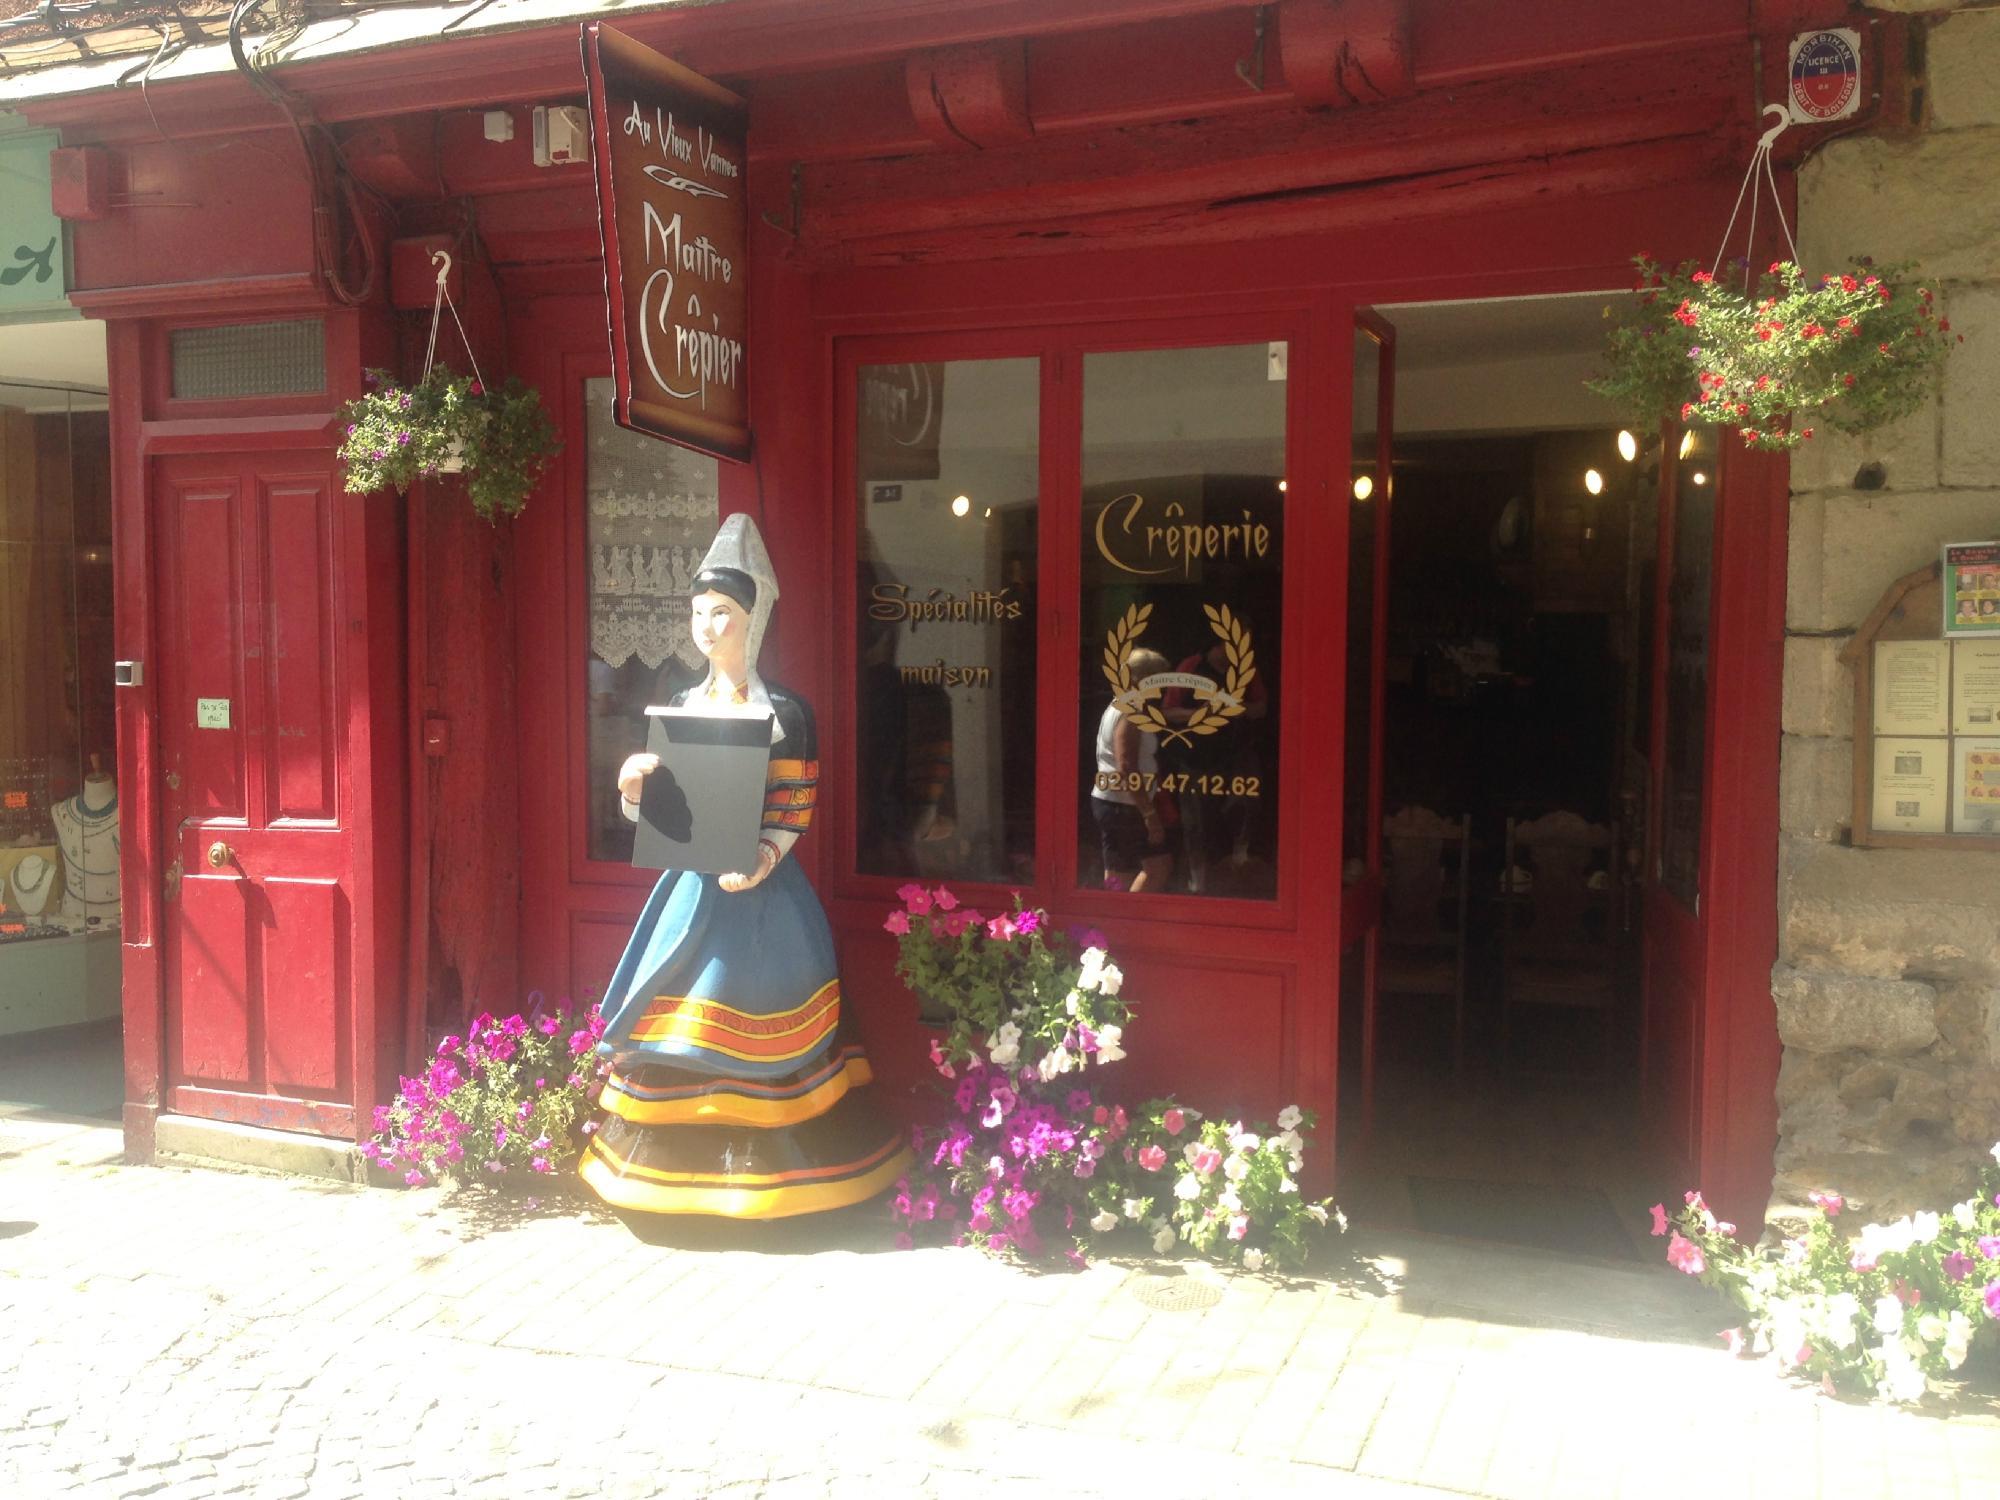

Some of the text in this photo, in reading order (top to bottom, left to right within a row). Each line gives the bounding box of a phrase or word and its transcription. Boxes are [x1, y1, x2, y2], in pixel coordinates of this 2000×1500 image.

[1797, 34, 1851, 64] MORBIHAN
[1808, 55, 1839, 66] LICENCE
[1808, 106, 1821, 116] DE
[1824, 76, 1855, 116] BOISSONS
[623, 100, 738, 177] Au Vieux Vannes
[643, 201, 733, 284] Maître
[639, 268, 742, 410] Crêpier
[1095, 493, 1270, 578] Crêperie
[868, 583, 1023, 633] Spécialités
[900, 658, 992, 688] maison
[1095, 771, 1260, 797] 02.97.47.12.62
